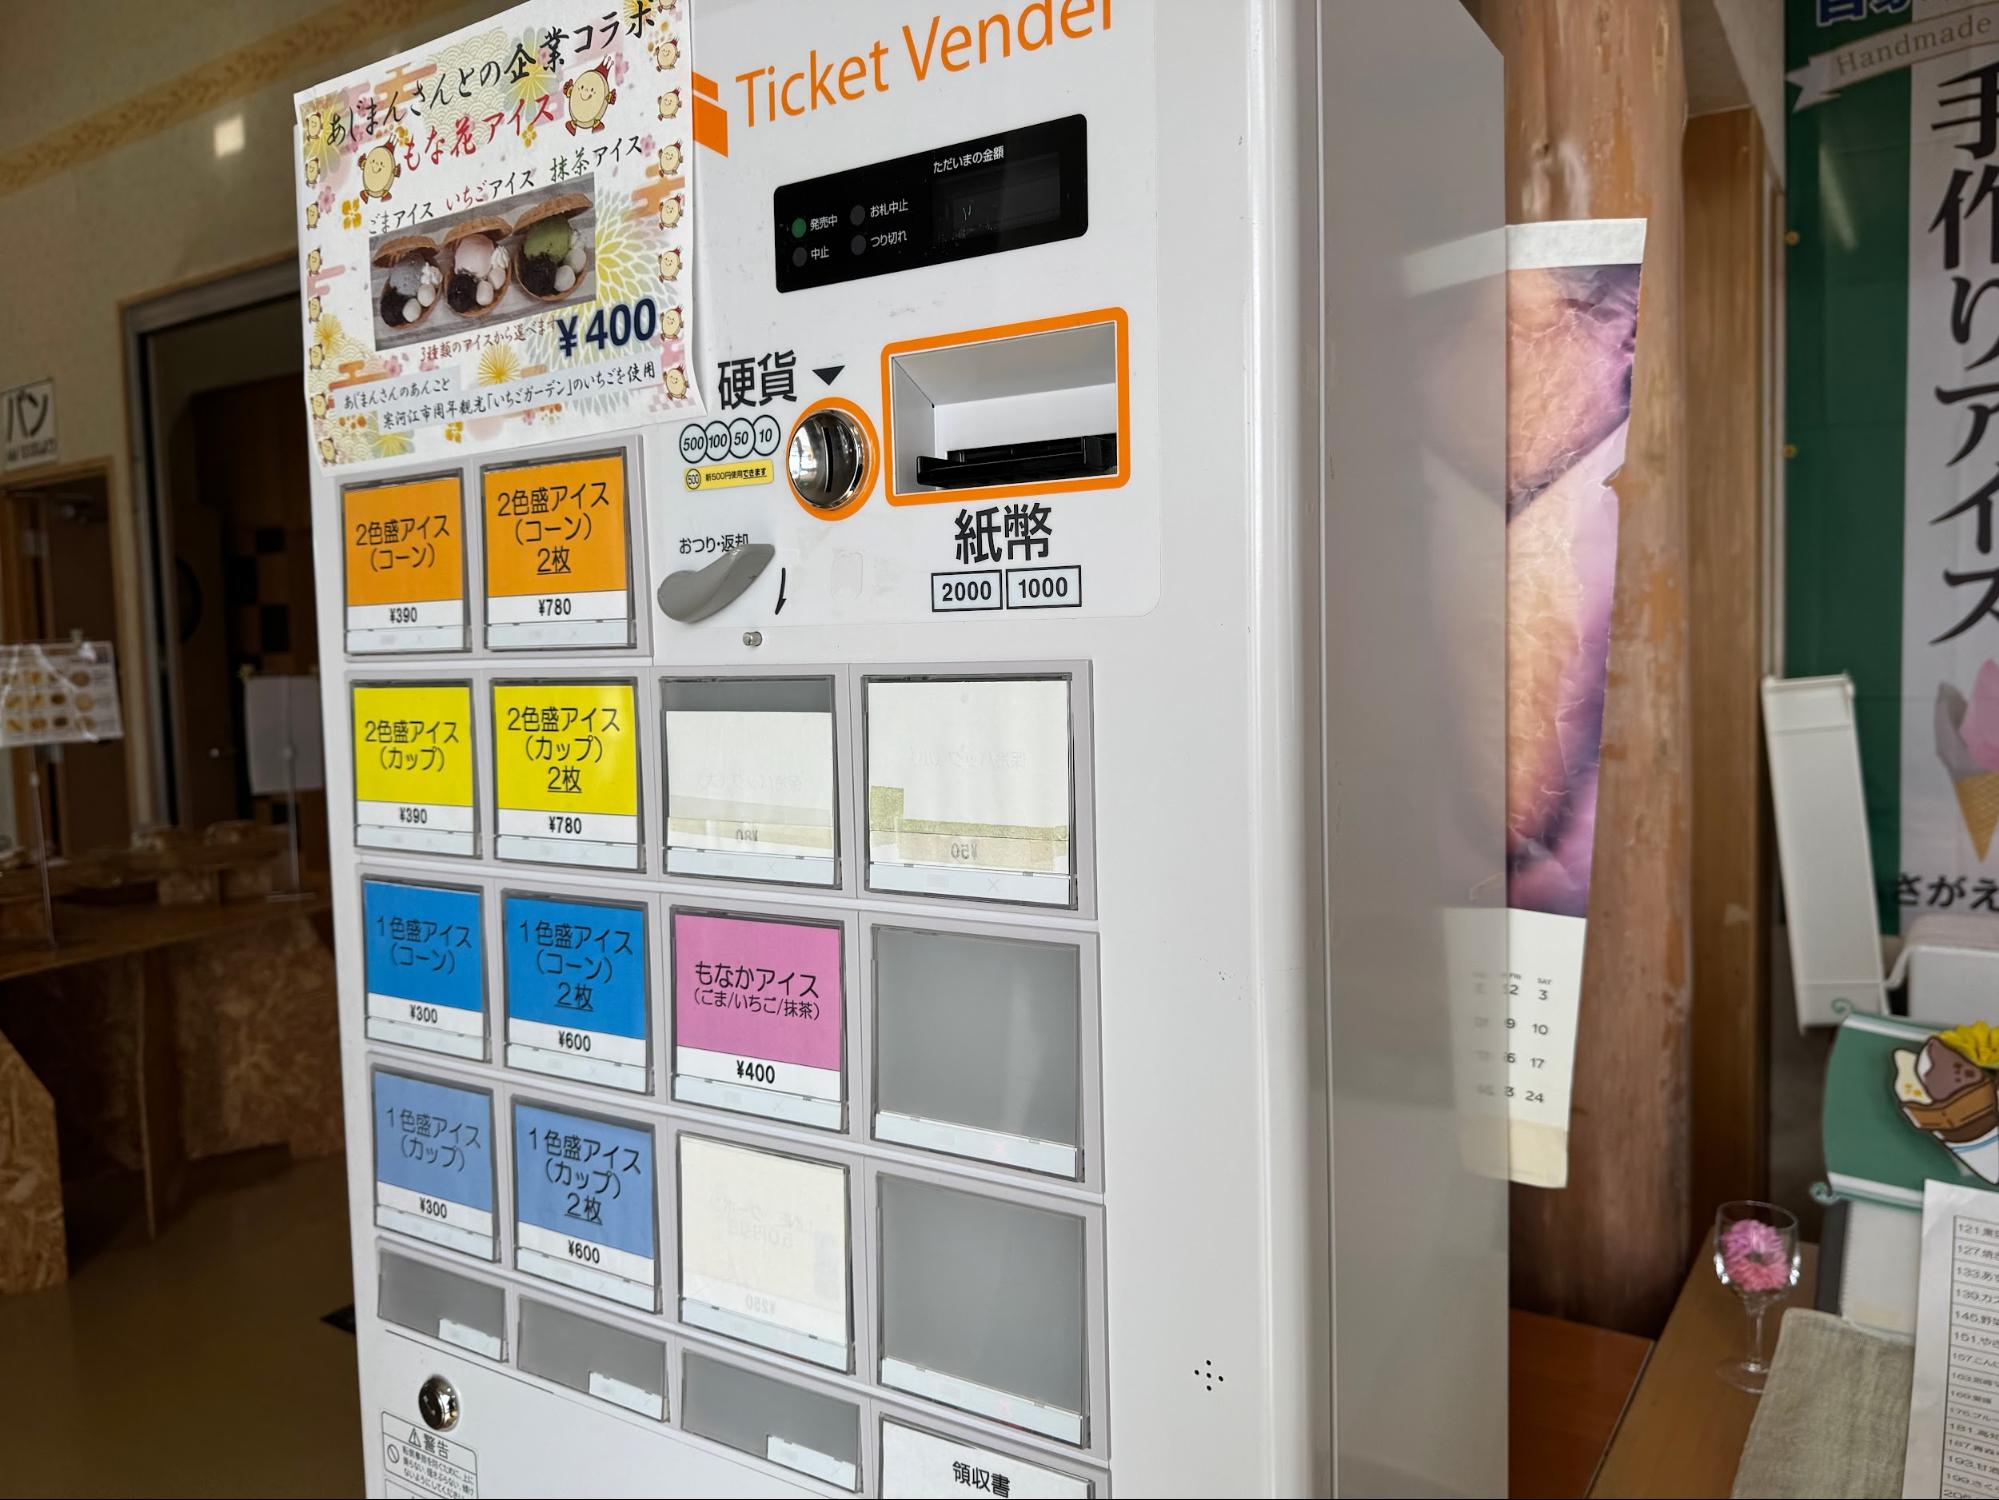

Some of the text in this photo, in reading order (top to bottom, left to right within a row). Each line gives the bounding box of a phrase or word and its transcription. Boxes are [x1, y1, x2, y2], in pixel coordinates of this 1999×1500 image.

[1836, 15, 1992, 75] Handmade
[735, 40, 889, 128] Ticket
[404, 94, 554, 171] もな花アイス
[933, 145, 1004, 174] ただいまの金額
[369, 135, 642, 235] ごまアイス いちごアイス 抹茶アイス
[810, 198, 909, 232] 発売中 お札中止
[811, 229, 908, 260] 中止 つり切れ
[557, 298, 657, 357] ¥400
[717, 349, 797, 410] 硬貨
[683, 428, 773, 452] 500 100 50 10
[496, 480, 610, 517] 2色盛アイス
[355, 513, 450, 547] 2色盛アイス
[954, 502, 1053, 565] 紙幣
[537, 546, 571, 573] 2枚
[942, 576, 1069, 602] 2000 1000
[389, 606, 418, 624] ¥390
[538, 598, 572, 617] ¥780
[364, 720, 460, 745] 2色盛アイス
[507, 706, 620, 734] 2色盛アイス
[547, 765, 582, 791] 2枚
[399, 807, 428, 825] ¥390
[549, 815, 582, 835] ¥780
[695, 960, 819, 999] もなかアイス
[555, 982, 594, 1010] 2枚
[1538, 989, 1548, 1001] 3
[410, 1004, 438, 1025] ¥300
[1506, 1018, 1549, 1035] 9 10
[558, 1030, 592, 1052] ¥600
[736, 1059, 776, 1084] ¥400
[1530, 1057, 1545, 1069] 17
[1525, 1090, 1544, 1102] 24
[419, 1197, 448, 1219] ¥300
[565, 1192, 603, 1224] 2枚
[568, 1239, 600, 1265] ¥600
[423, 1433, 449, 1459] 警告
[952, 1461, 1010, 1498] 領収書
